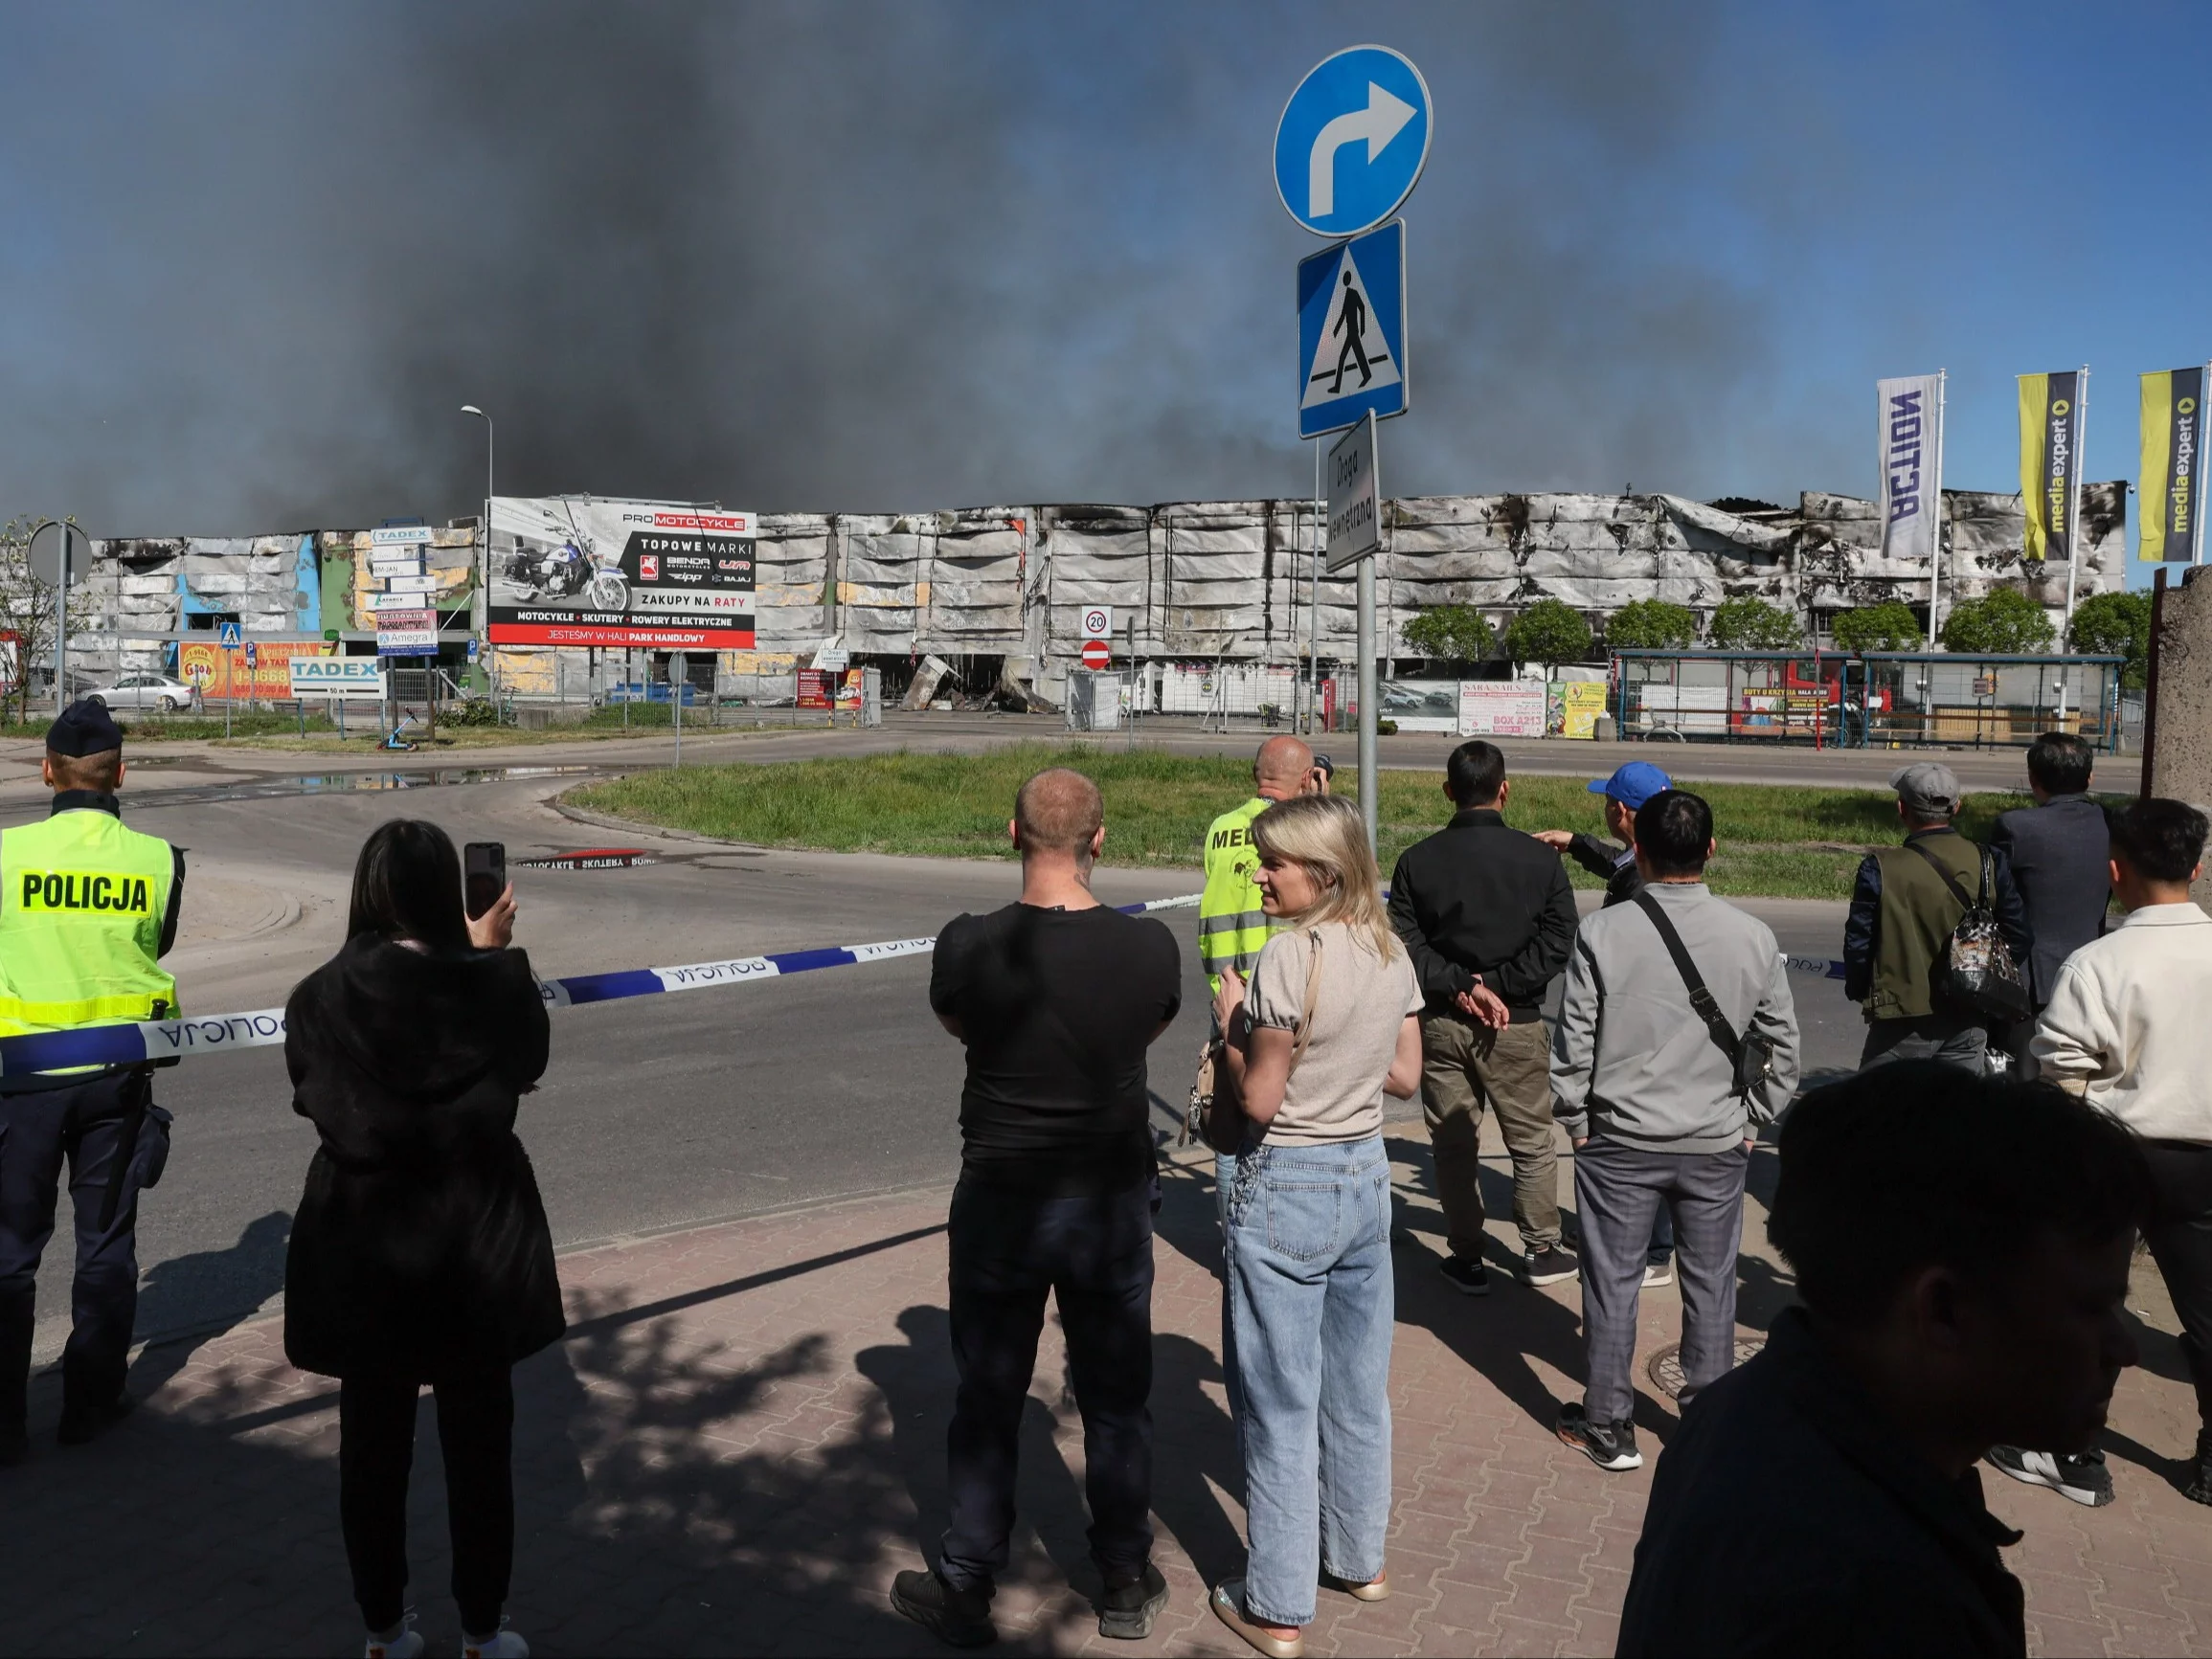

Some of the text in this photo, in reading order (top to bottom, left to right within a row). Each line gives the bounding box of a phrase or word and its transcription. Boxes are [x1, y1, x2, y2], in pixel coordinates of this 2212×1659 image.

[1337, 449, 1358, 487] Droga
[2048, 418, 2069, 532] mediaexpert
[2171, 416, 2194, 533] mediaexpert
[641, 538, 752, 554] TOPOWE MARKI
[642, 594, 745, 607] ZAKUPY NA RATY
[517, 611, 733, 626] MOTOCYKLE SKUTERY ROWERY ELEKTRYCZNE
[1090, 617, 1104, 628] 20
[391, 633, 428, 643] Amegra
[547, 629, 705, 642] JESTEŚMY W HALI PARK HANDLOWY
[291, 662, 378, 676] TADEX
[1494, 715, 1513, 725] BOX
[23, 873, 147, 912] POLICJA
